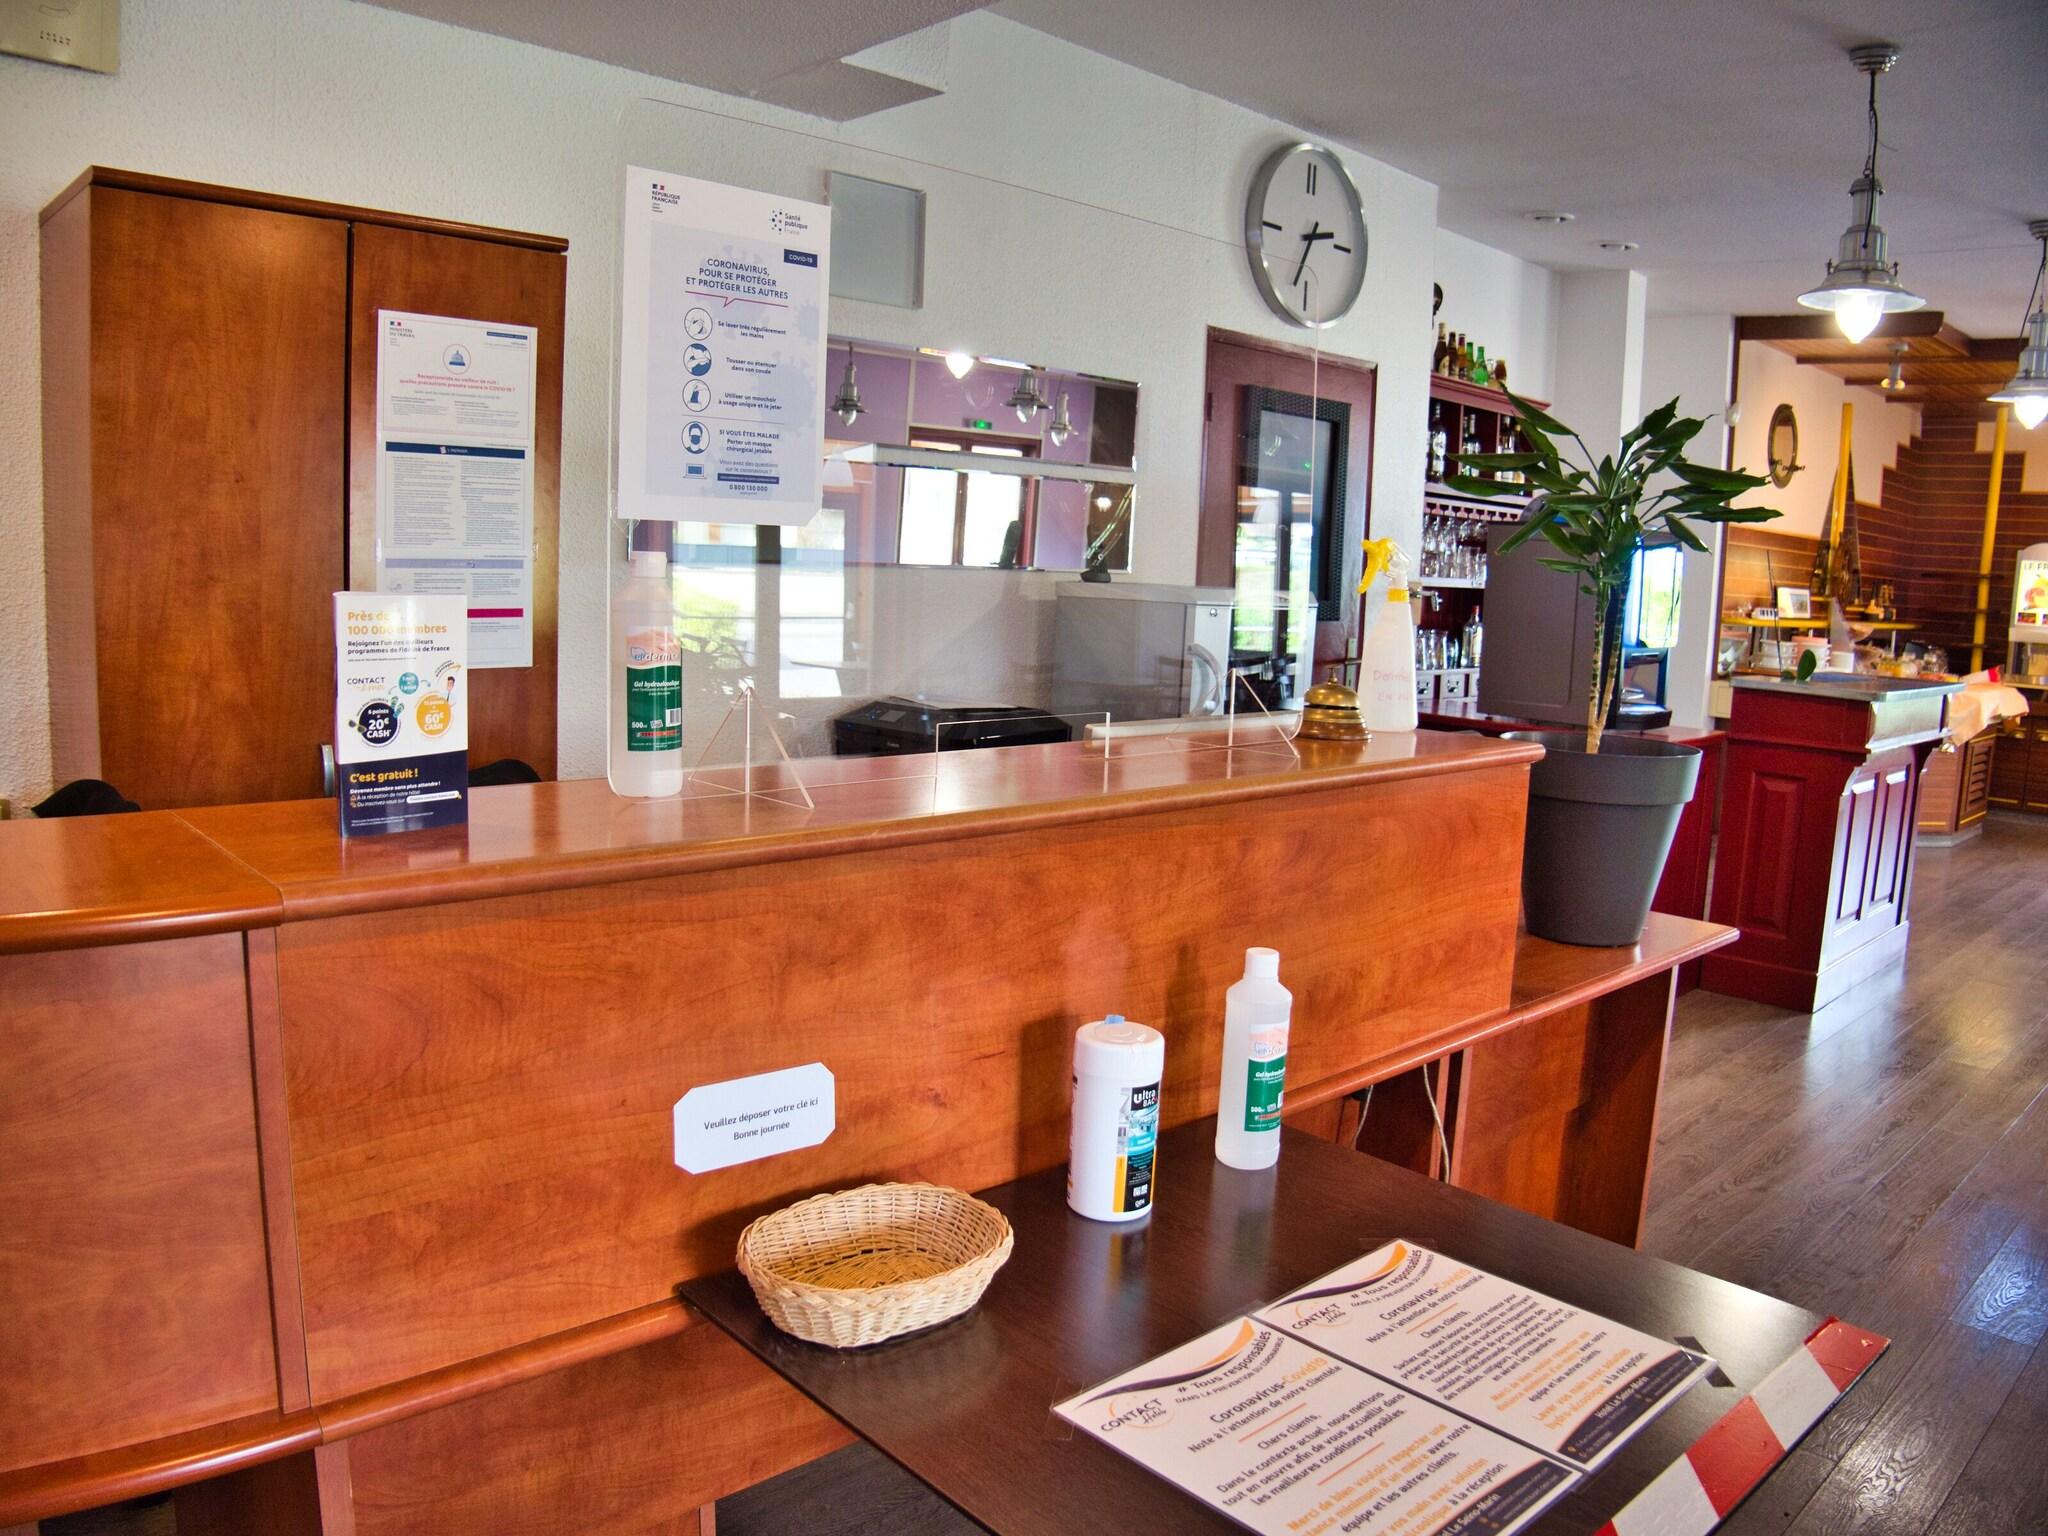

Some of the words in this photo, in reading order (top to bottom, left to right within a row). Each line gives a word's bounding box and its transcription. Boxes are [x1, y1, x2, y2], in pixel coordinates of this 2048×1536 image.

[785, 212, 801, 221] Santé
[785, 220, 808, 230] publique
[707, 258, 770, 276] CORONAVIRUS,
[788, 254, 813, 264] COVID-19
[699, 268, 722, 279] POUR
[724, 272, 734, 280] SE
[736, 274, 777, 287] PROTÉGER
[686, 277, 696, 285] ET
[698, 278, 741, 293] PROTÉGER
[743, 285, 756, 294] LES
[758, 287, 788, 300] AUTRES
[743, 429, 755, 437] ÊTES
[347, 610, 374, 622] Près
[347, 626, 368, 636] 100
[347, 677, 385, 685] CONTACT
[350, 774, 375, 783] C'est
[378, 770, 413, 782] gratuit
[415, 768, 418, 777] !
[1134, 1089, 1156, 1104] Ultra
[704, 1116, 736, 1130] Veuillez
[738, 1109, 771, 1123] déposer
[773, 1104, 794, 1114] votre
[797, 1100, 808, 1109] clé
[809, 1097, 818, 1107] ici
[734, 1128, 758, 1140] Bonne
[760, 1121, 790, 1136] journée
[1362, 1285, 1388, 1295] Tous
[1388, 1250, 1422, 1286] responsables
[1292, 1303, 1341, 1330] CONTACT
[1366, 1331, 1387, 1344] Note
[1420, 1323, 1446, 1338] Chers
[1191, 1376, 1222, 1388] Tous
[1223, 1331, 1271, 1377] responsables
[1100, 1398, 1162, 1432] CONTACT
[1188, 1434, 1216, 1453] Note
[1216, 1431, 1223, 1439] à
[1220, 1405, 1271, 1435] l'attention
[1269, 1399, 1281, 1408] de
[1282, 1386, 1307, 1402] notre
[1306, 1364, 1342, 1389] clientèle
[1216, 1474, 1245, 1493] Dans
[1243, 1466, 1256, 1477] le
[1256, 1444, 1298, 1472] contexte
[1328, 1412, 1350, 1428] nous
[1349, 1391, 1384, 1414] mettons
[1257, 1431, 1288, 1450] Chers
[1427, 1440, 1449, 1455] avec
[1448, 1423, 1471, 1441] notre
[1222, 1490, 1247, 1506] tout
[1249, 1484, 1261, 1493] en
[1294, 1450, 1313, 1464] afin
[1312, 1442, 1324, 1453] de
[1323, 1429, 1348, 1445] vous
[1347, 1404, 1384, 1432] accueillir
[1383, 1392, 1406, 1408] dans
[1250, 1493, 1271, 1506] les
[1270, 1462, 1320, 1496] meilleures
[1320, 1433, 1366, 1464] conditions
[1341, 1509, 1375, 1533] équipe
[1373, 1501, 1386, 1512] et
[1381, 1492, 1401, 1504] les
[1400, 1472, 1429, 1493] autres
[1452, 1492, 1468, 1502] la
[1286, 1508, 1318, 1531] Merci
